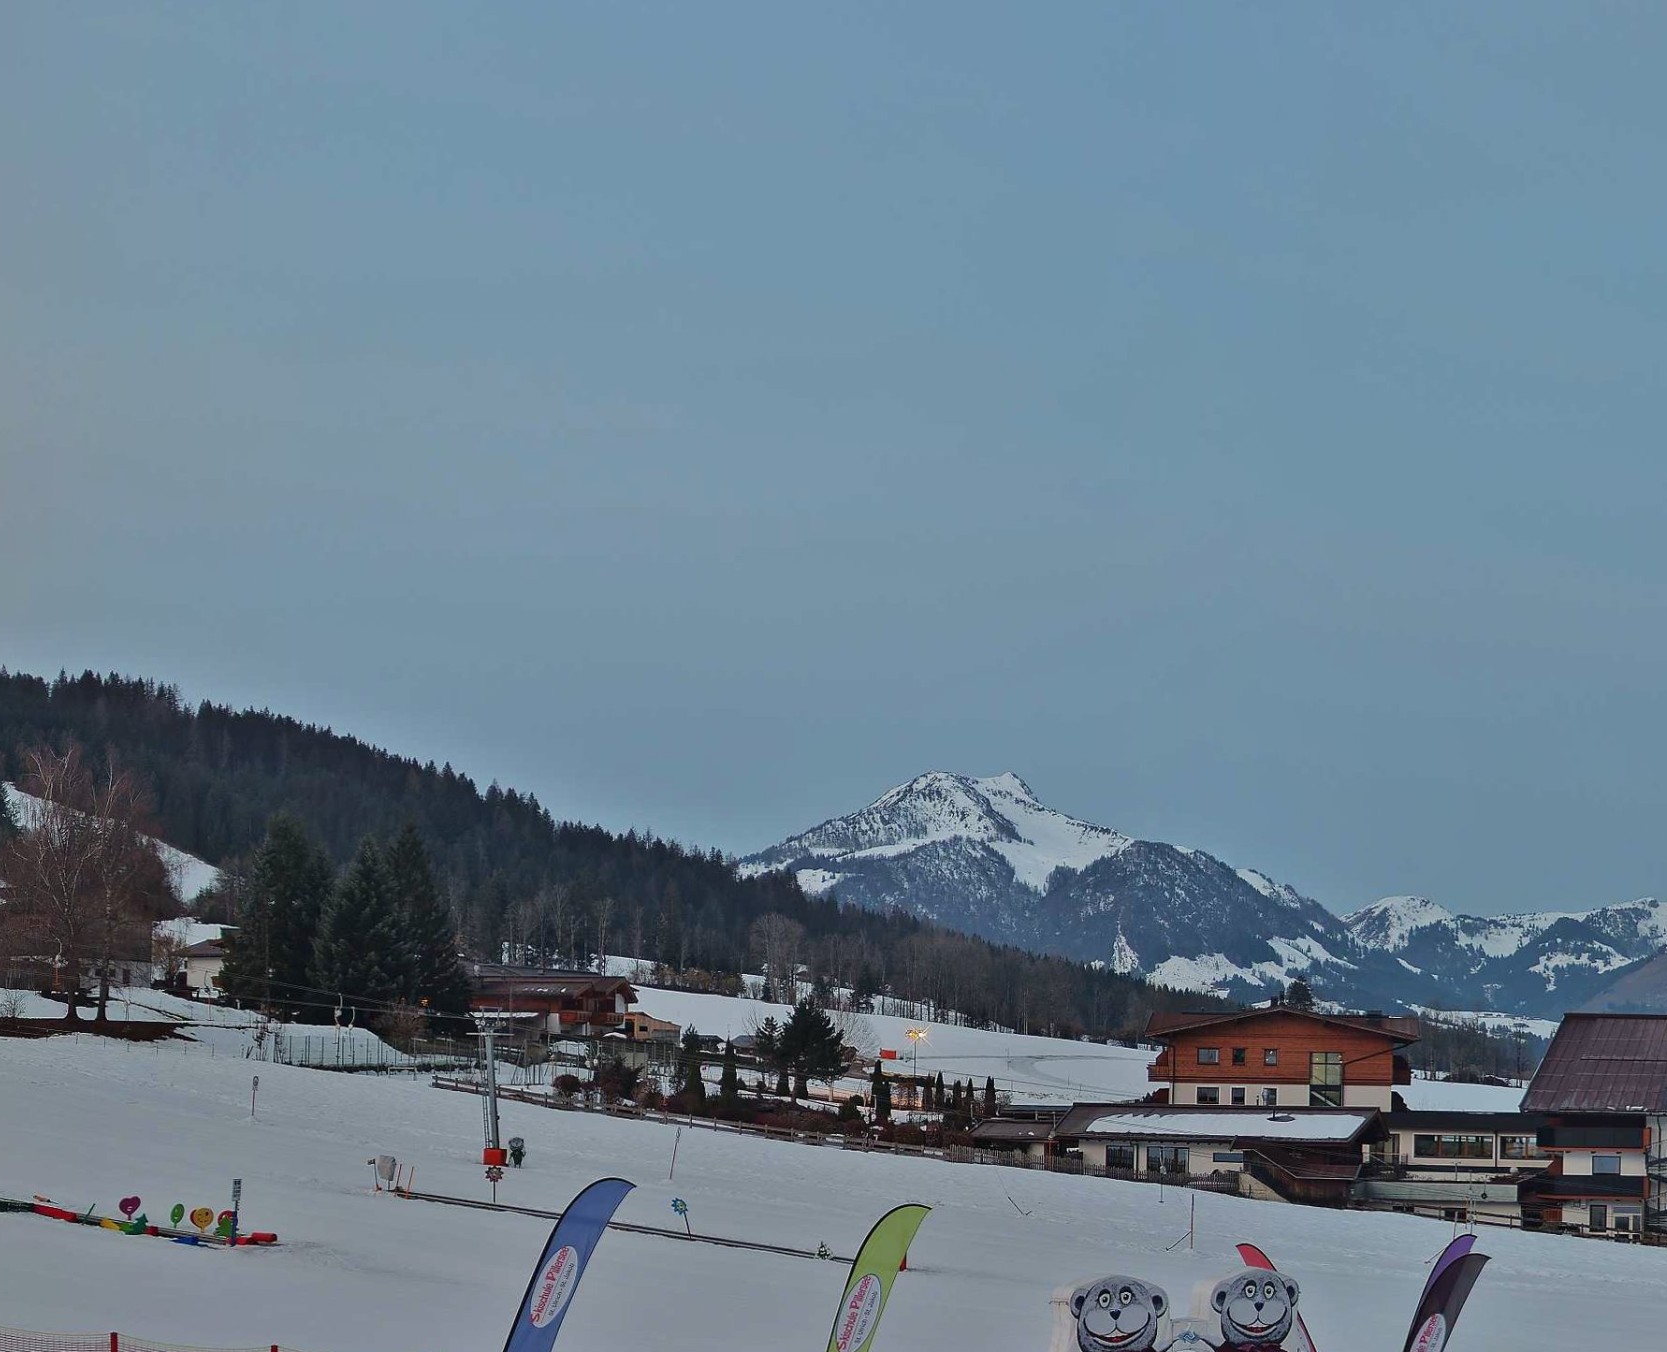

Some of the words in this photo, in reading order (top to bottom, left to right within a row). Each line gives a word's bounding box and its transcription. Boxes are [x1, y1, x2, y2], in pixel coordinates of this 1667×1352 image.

[530, 1283, 554, 1324] Skischule
[545, 1246, 569, 1281] Pillersee
[836, 1311, 858, 1351] Skischule
